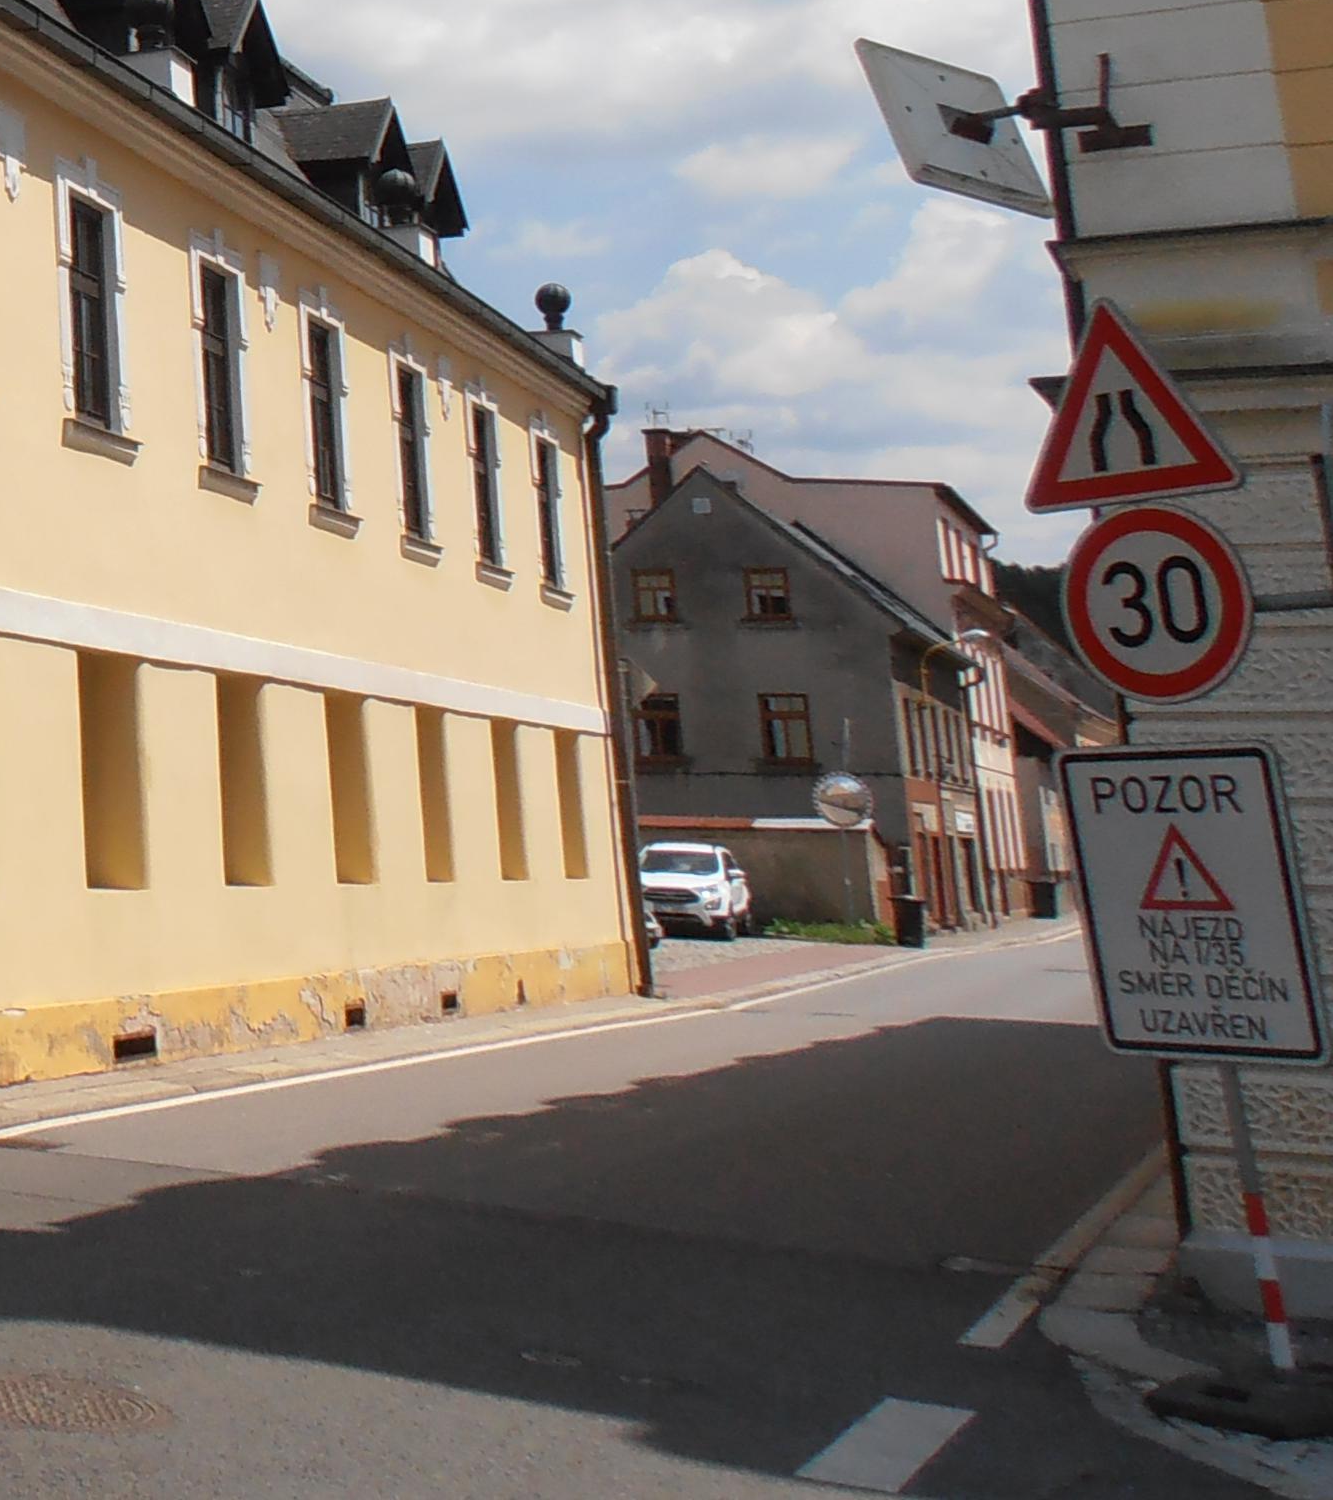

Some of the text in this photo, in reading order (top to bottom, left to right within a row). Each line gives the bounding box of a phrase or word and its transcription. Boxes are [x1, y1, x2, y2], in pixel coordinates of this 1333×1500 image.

[1101, 555, 1209, 648] 30
[1090, 774, 1244, 813] POZOR
[1138, 913, 1244, 942] NÁJEZD
[1149, 940, 1245, 967] NA I/35
[1118, 963, 1290, 1003] SMĚR DĚČÍN
[1138, 1006, 1269, 1042] UZAVŘEN
